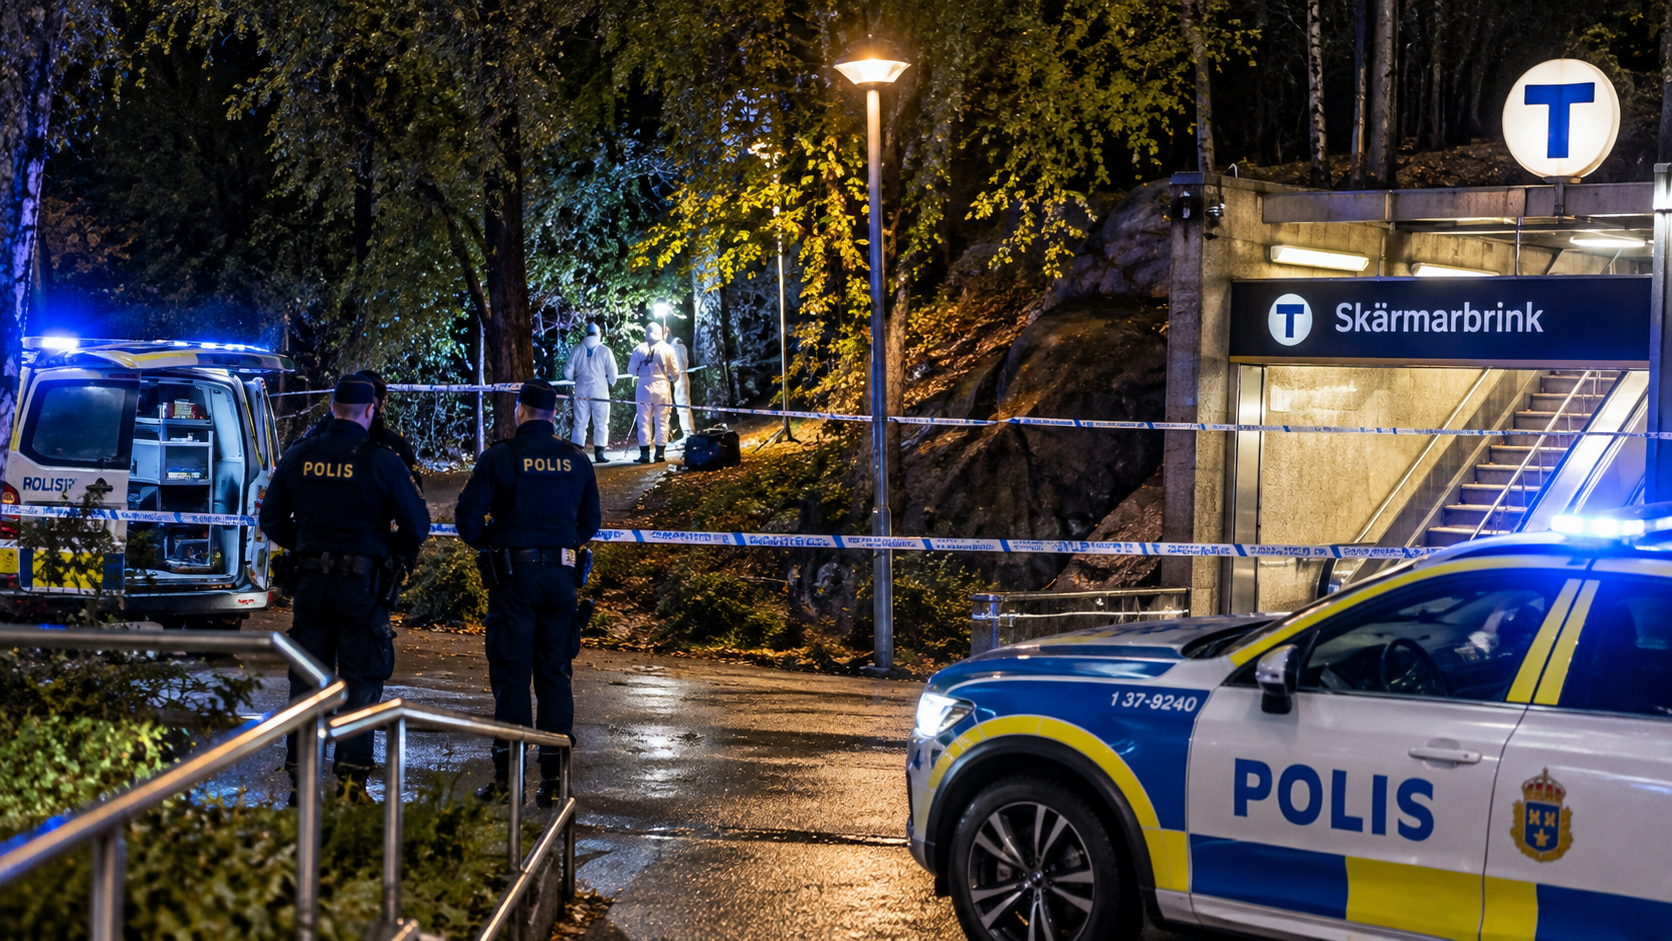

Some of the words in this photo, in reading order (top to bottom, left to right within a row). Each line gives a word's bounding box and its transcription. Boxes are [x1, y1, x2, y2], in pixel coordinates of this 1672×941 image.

[1524, 82, 1595, 158] T
[1276, 303, 1305, 338] T
[1335, 301, 1544, 333] Skärmarbrink
[303, 461, 354, 478] POLIS
[523, 458, 572, 472] POLIS
[1122, 692, 1198, 712] 37-9240
[1234, 758, 1435, 842] POLIS
